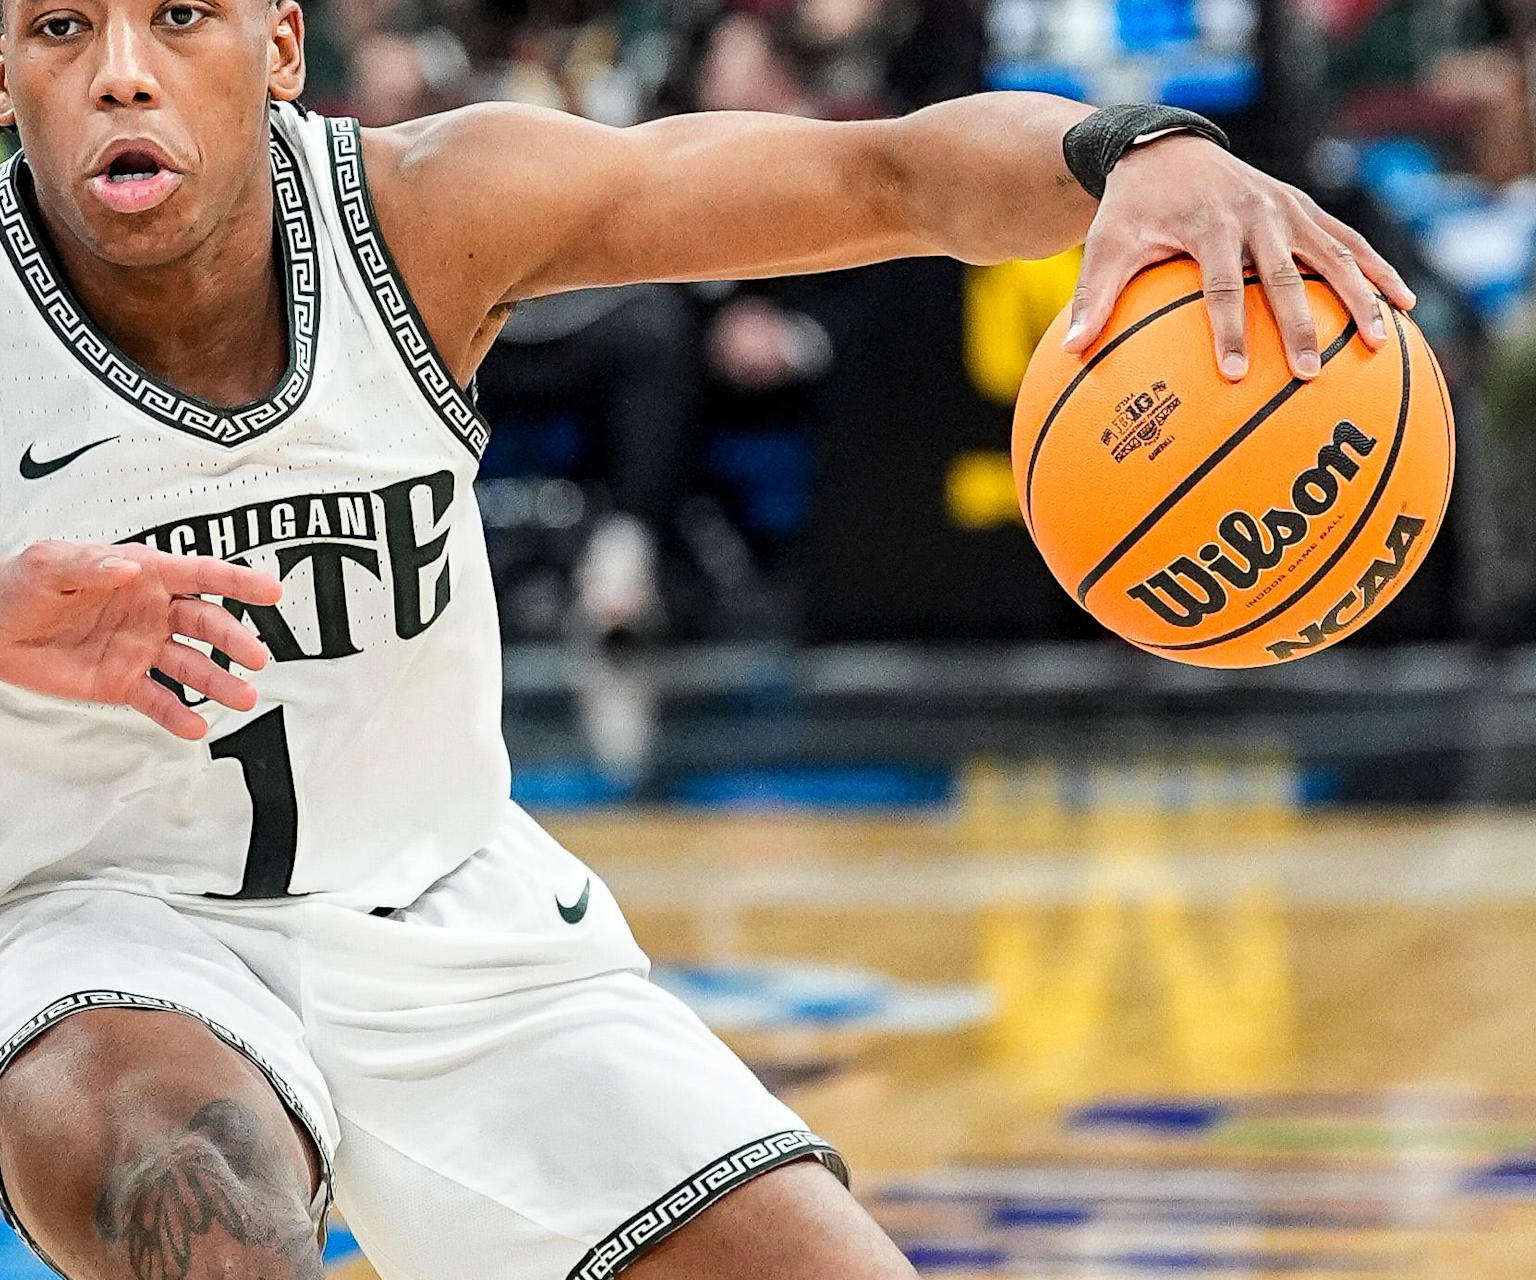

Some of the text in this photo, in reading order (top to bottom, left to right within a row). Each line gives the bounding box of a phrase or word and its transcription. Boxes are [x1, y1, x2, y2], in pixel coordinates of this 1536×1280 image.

[1126, 418, 1378, 630] Wilson
[1245, 512, 1345, 609] INDOOR GAME BALL
[1265, 514, 1427, 661] NCAA
[202, 704, 312, 900] 1
